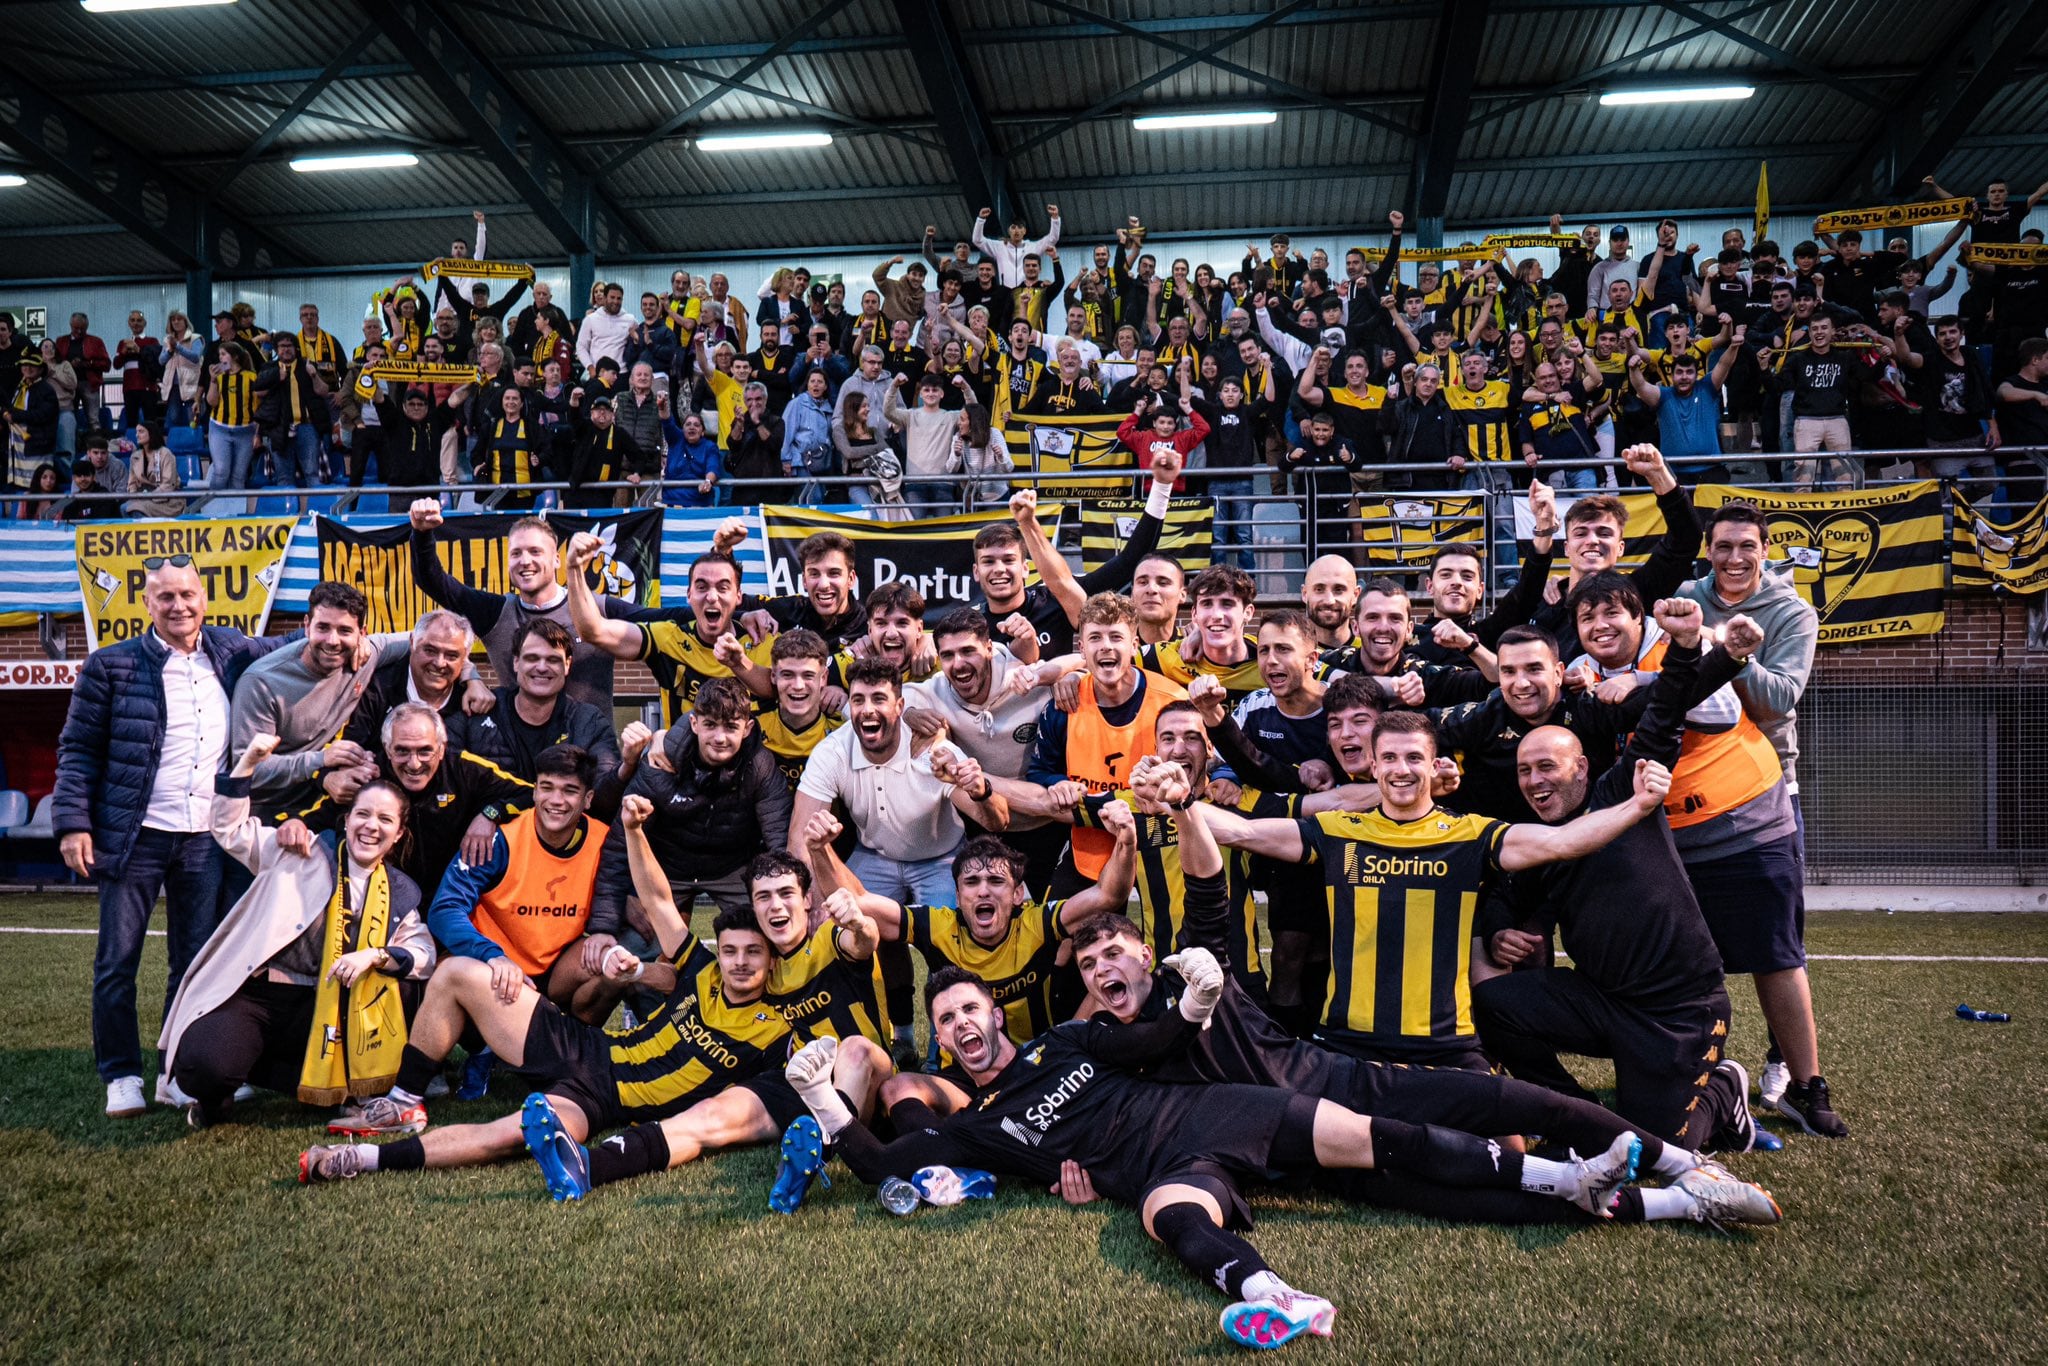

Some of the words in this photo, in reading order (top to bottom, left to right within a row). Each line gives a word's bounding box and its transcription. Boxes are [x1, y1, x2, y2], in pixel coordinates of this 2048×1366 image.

[1830, 212, 1883, 226] PORTU
[1908, 203, 1960, 219] HOOLS
[1974, 246, 2029, 260] PORTU
[1045, 487, 1068, 497] Club
[1097, 500, 1127, 509] Club
[84, 527, 212, 557] ESKERRIK
[221, 524, 292, 552] ASKO
[1825, 529, 1870, 543] PORTU
[1817, 619, 1913, 641] ORIBELTZA
[1363, 855, 1449, 877] Sobrino
[1363, 875, 1386, 884] OHLA
[992, 971, 1037, 999] brino
[685, 1014, 739, 1069] Sobrino
[1026, 1062, 1095, 1126] Sobrino
